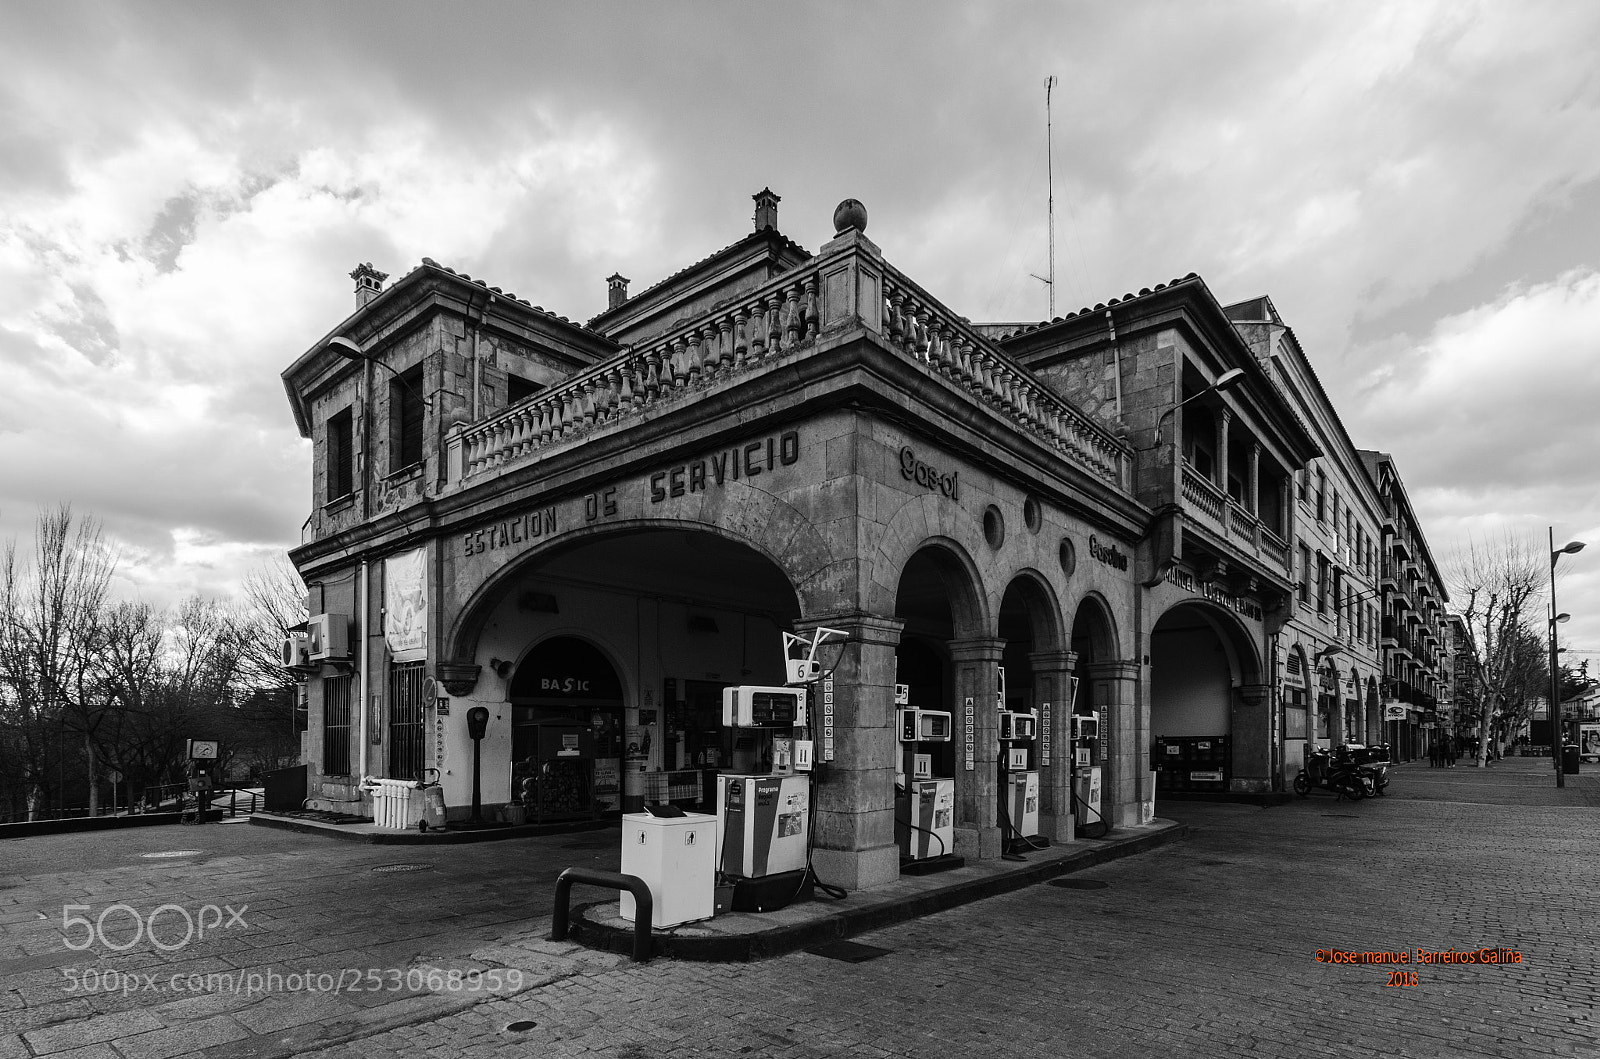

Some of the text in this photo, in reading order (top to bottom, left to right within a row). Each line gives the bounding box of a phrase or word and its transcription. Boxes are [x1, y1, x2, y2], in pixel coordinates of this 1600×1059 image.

[465, 431, 798, 557] ESTACION DE SERVICIO
[798, 665, 805, 679] 6
[541, 678, 590, 693] BASIC
[903, 688, 908, 700] 5
